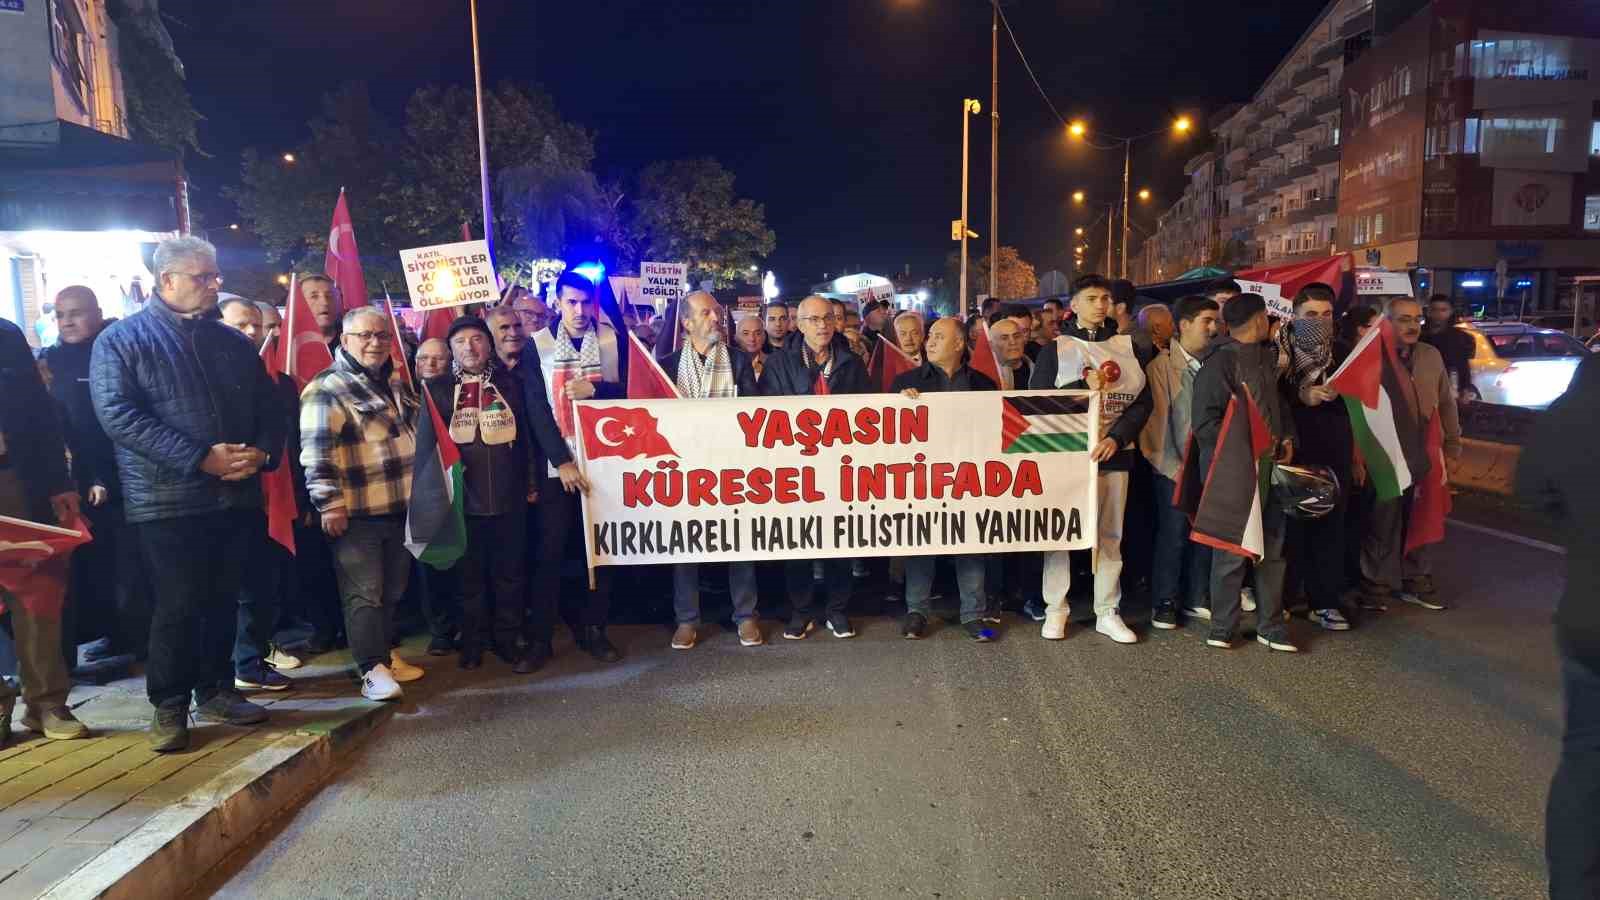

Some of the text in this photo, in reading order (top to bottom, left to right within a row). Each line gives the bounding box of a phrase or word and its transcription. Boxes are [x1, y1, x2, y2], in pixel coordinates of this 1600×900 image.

[463, 265, 480, 276] VE
[645, 263, 682, 275] FİLİSTİN
[648, 277, 680, 286] YALNIZ
[736, 406, 929, 457] YAŞASIN
[622, 452, 1044, 509] KÜRESEL İNTİFADA
[594, 502, 1083, 558] KIRKLARELİ HALKI FİLİSTİN'İN YANINDA
